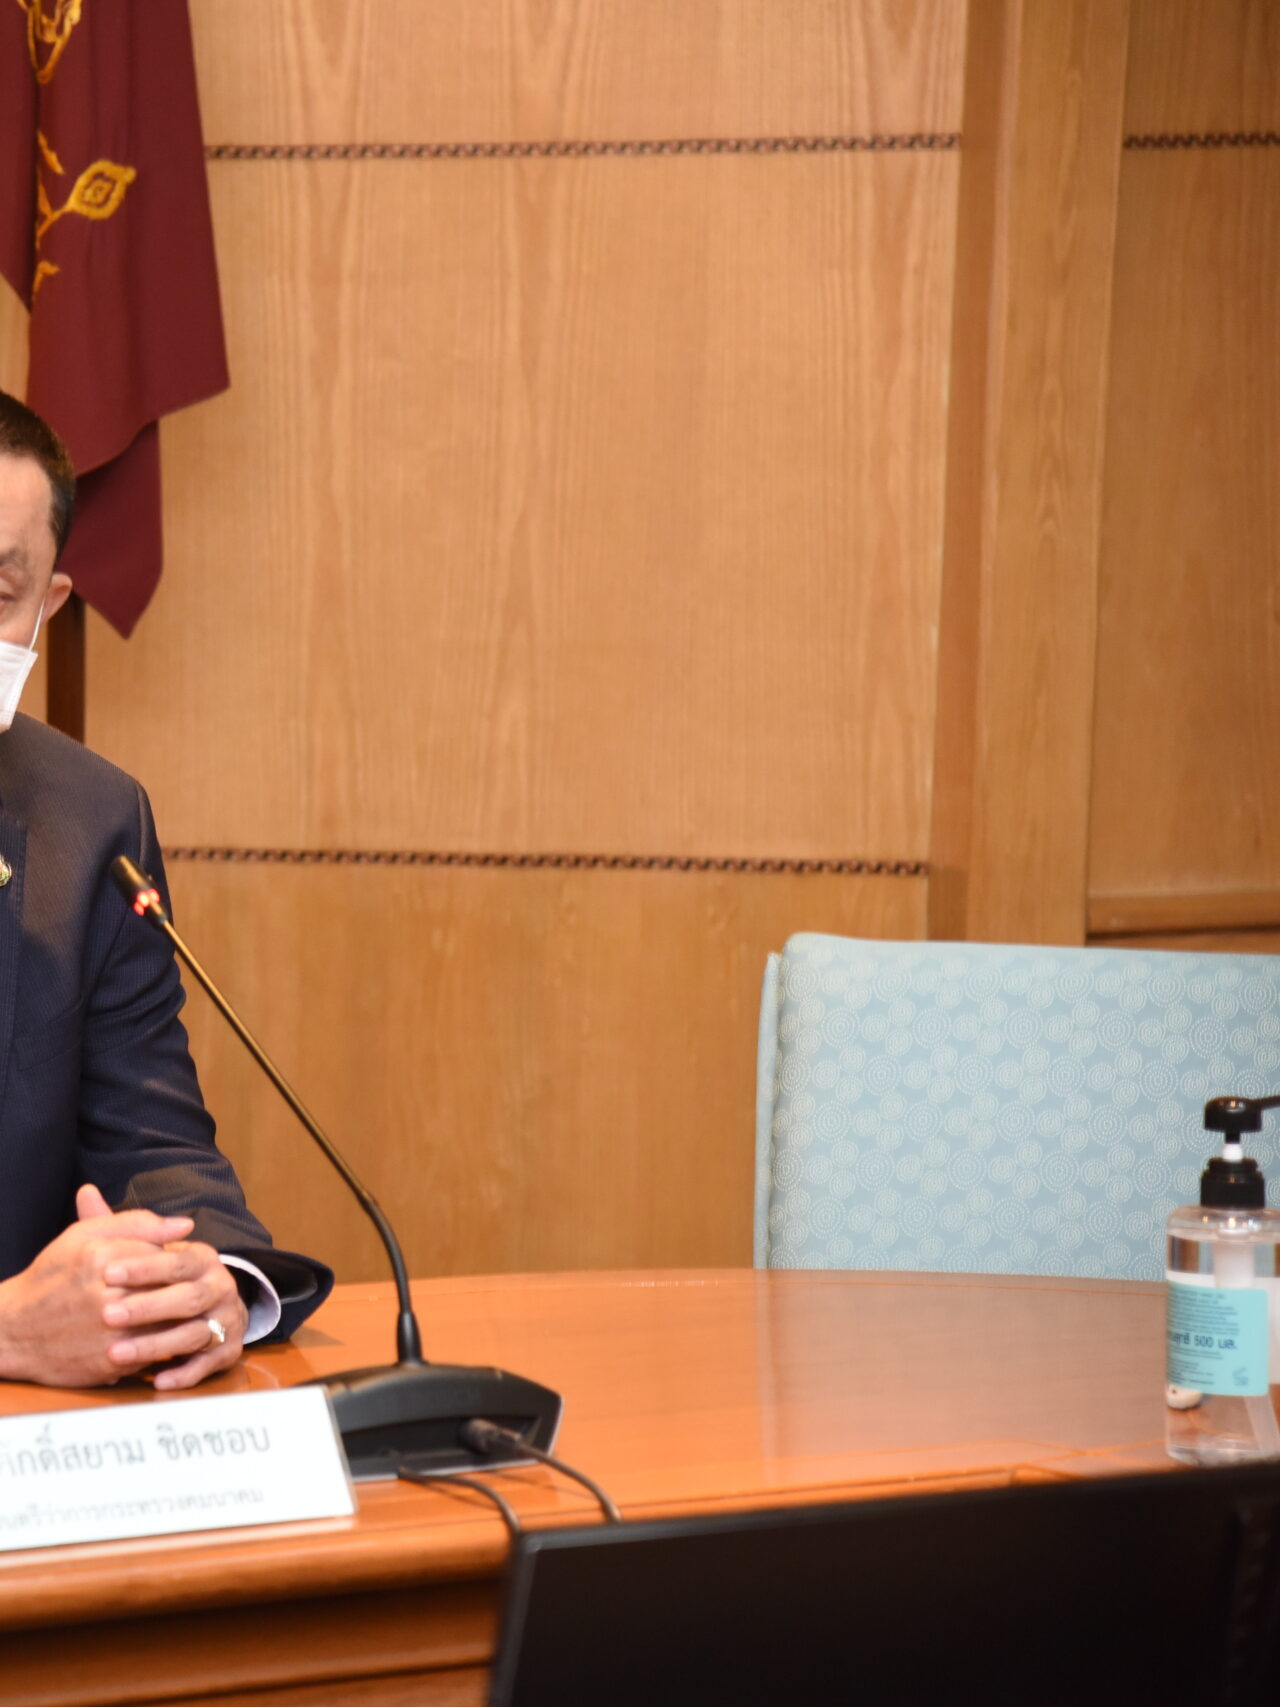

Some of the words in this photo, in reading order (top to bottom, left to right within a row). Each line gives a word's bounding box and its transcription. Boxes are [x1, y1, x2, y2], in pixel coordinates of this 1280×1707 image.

[1193, 1334, 1214, 1348] 500
[156, 1422, 272, 1462] ชิดชอบ
